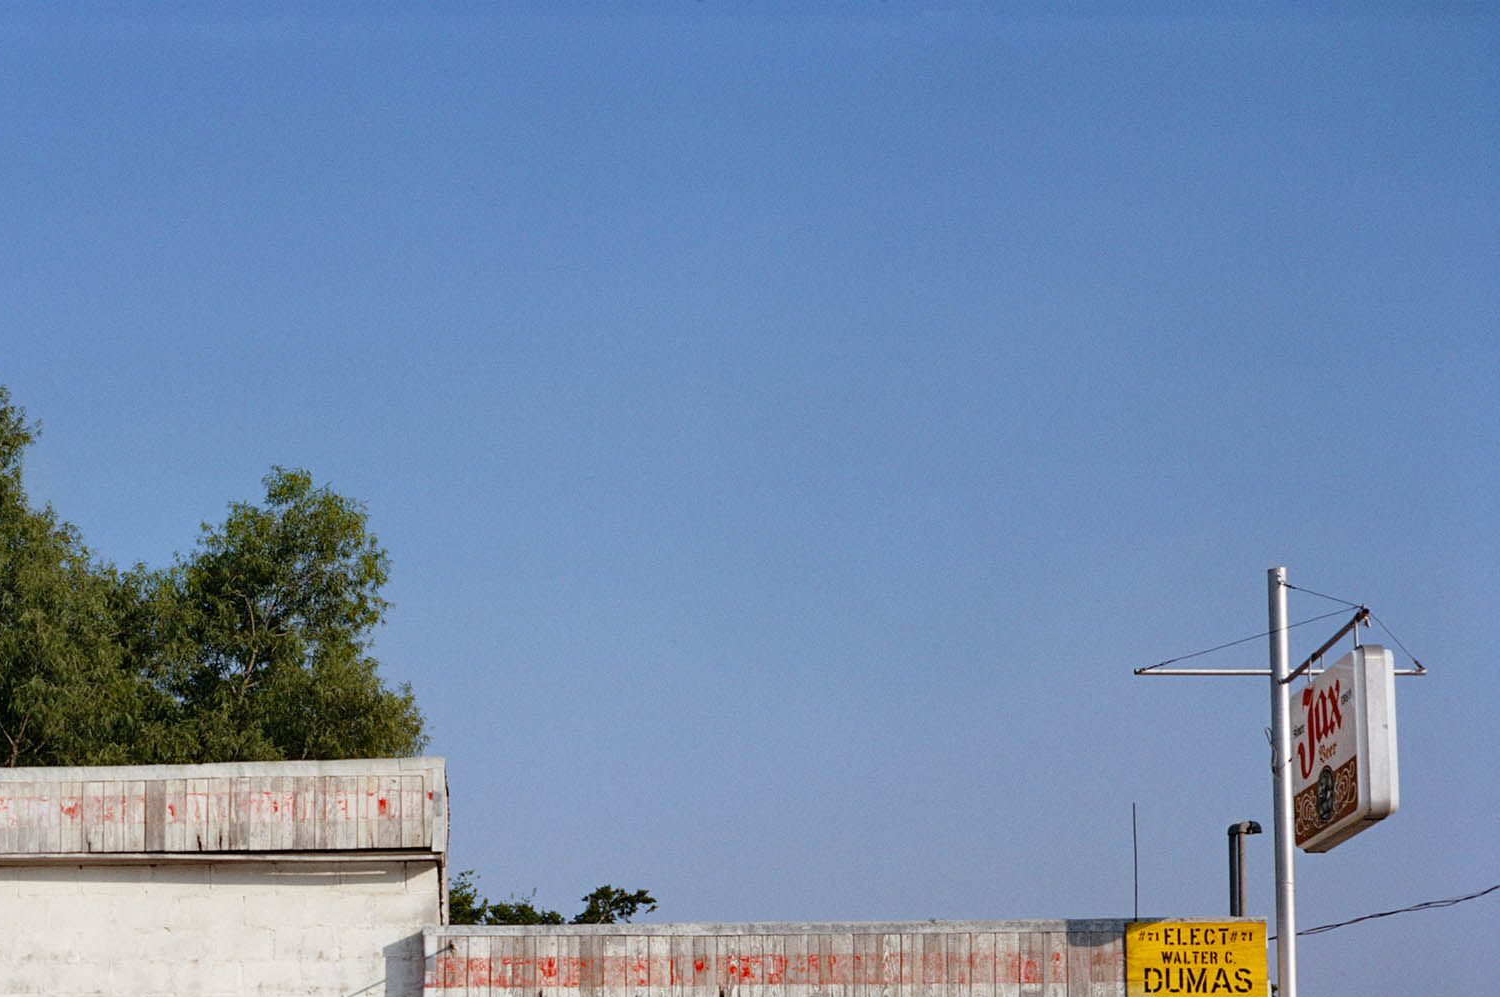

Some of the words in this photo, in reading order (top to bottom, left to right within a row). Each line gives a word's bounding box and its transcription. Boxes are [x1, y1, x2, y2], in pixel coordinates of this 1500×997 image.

[1297, 678, 1342, 780] Jax
[1164, 928, 1229, 945] ELECT
[1161, 951, 1218, 965] WALTER
[1224, 951, 1237, 965] C.
[1144, 968, 1252, 993] DUMAS
